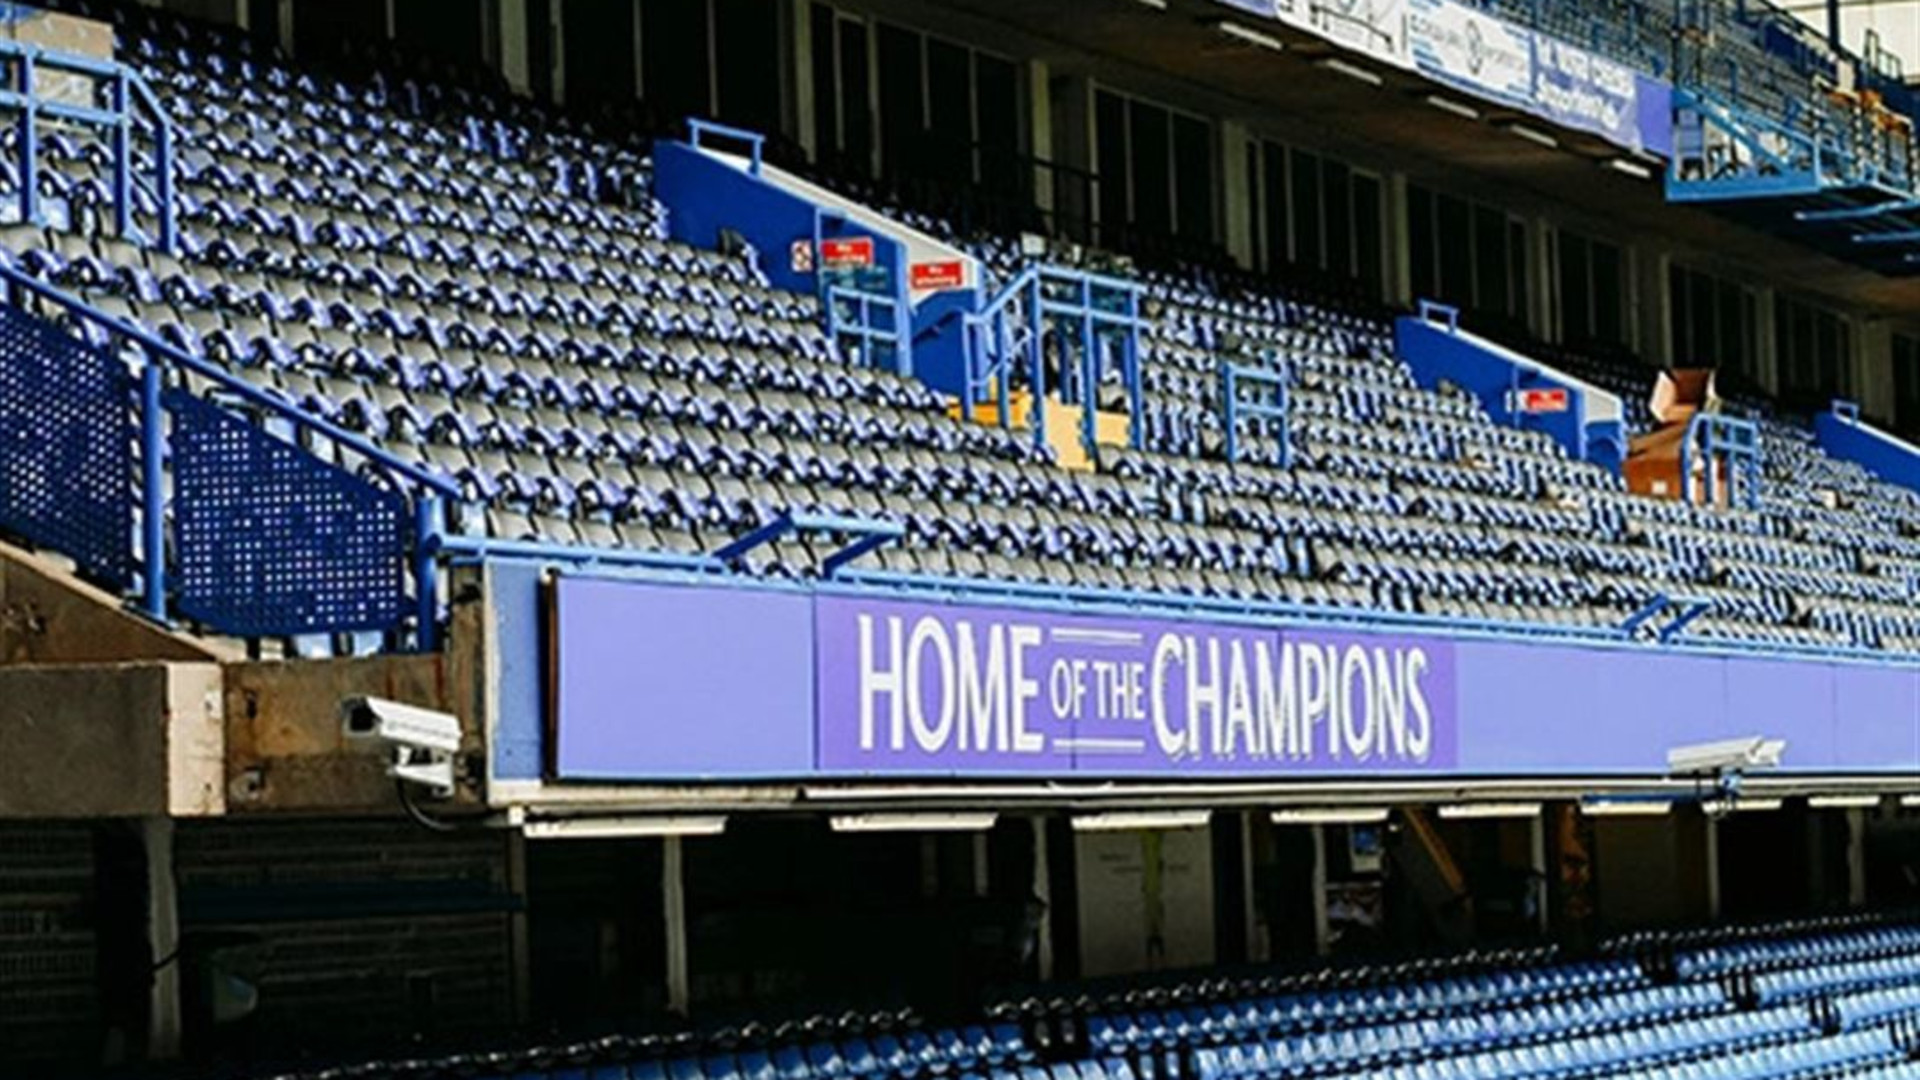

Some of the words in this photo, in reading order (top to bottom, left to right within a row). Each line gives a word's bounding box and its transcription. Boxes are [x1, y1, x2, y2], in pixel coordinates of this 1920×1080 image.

[858, 614, 1044, 753] HOME
[1050, 658, 1086, 720] OF
[1094, 660, 1145, 720] THE
[1150, 632, 1431, 761] CHAMPIONS
